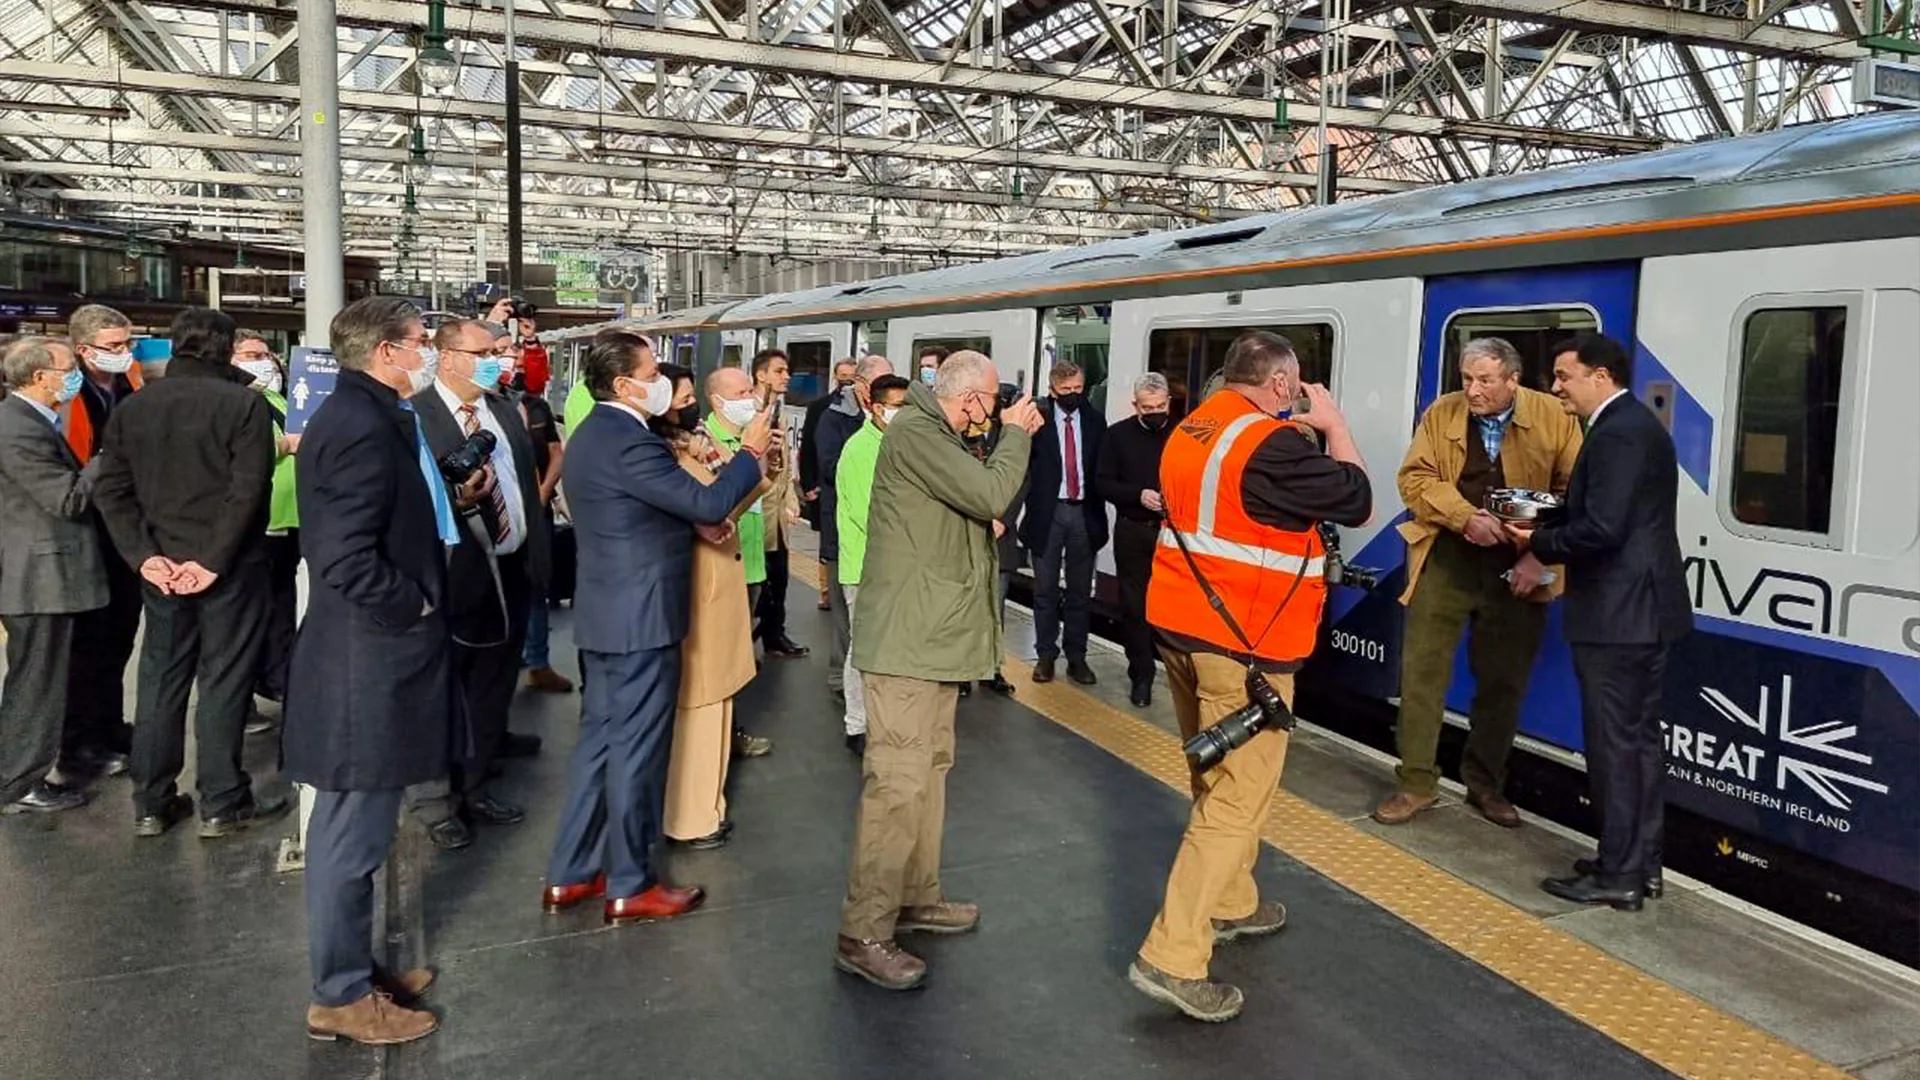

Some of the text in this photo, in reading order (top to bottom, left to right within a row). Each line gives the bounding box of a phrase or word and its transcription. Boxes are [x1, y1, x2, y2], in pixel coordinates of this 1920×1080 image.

[484, 283, 492, 295] 7
[1331, 629, 1385, 663] 300101
[1665, 762, 1850, 833] AIN & NORTHERN IRELAND
